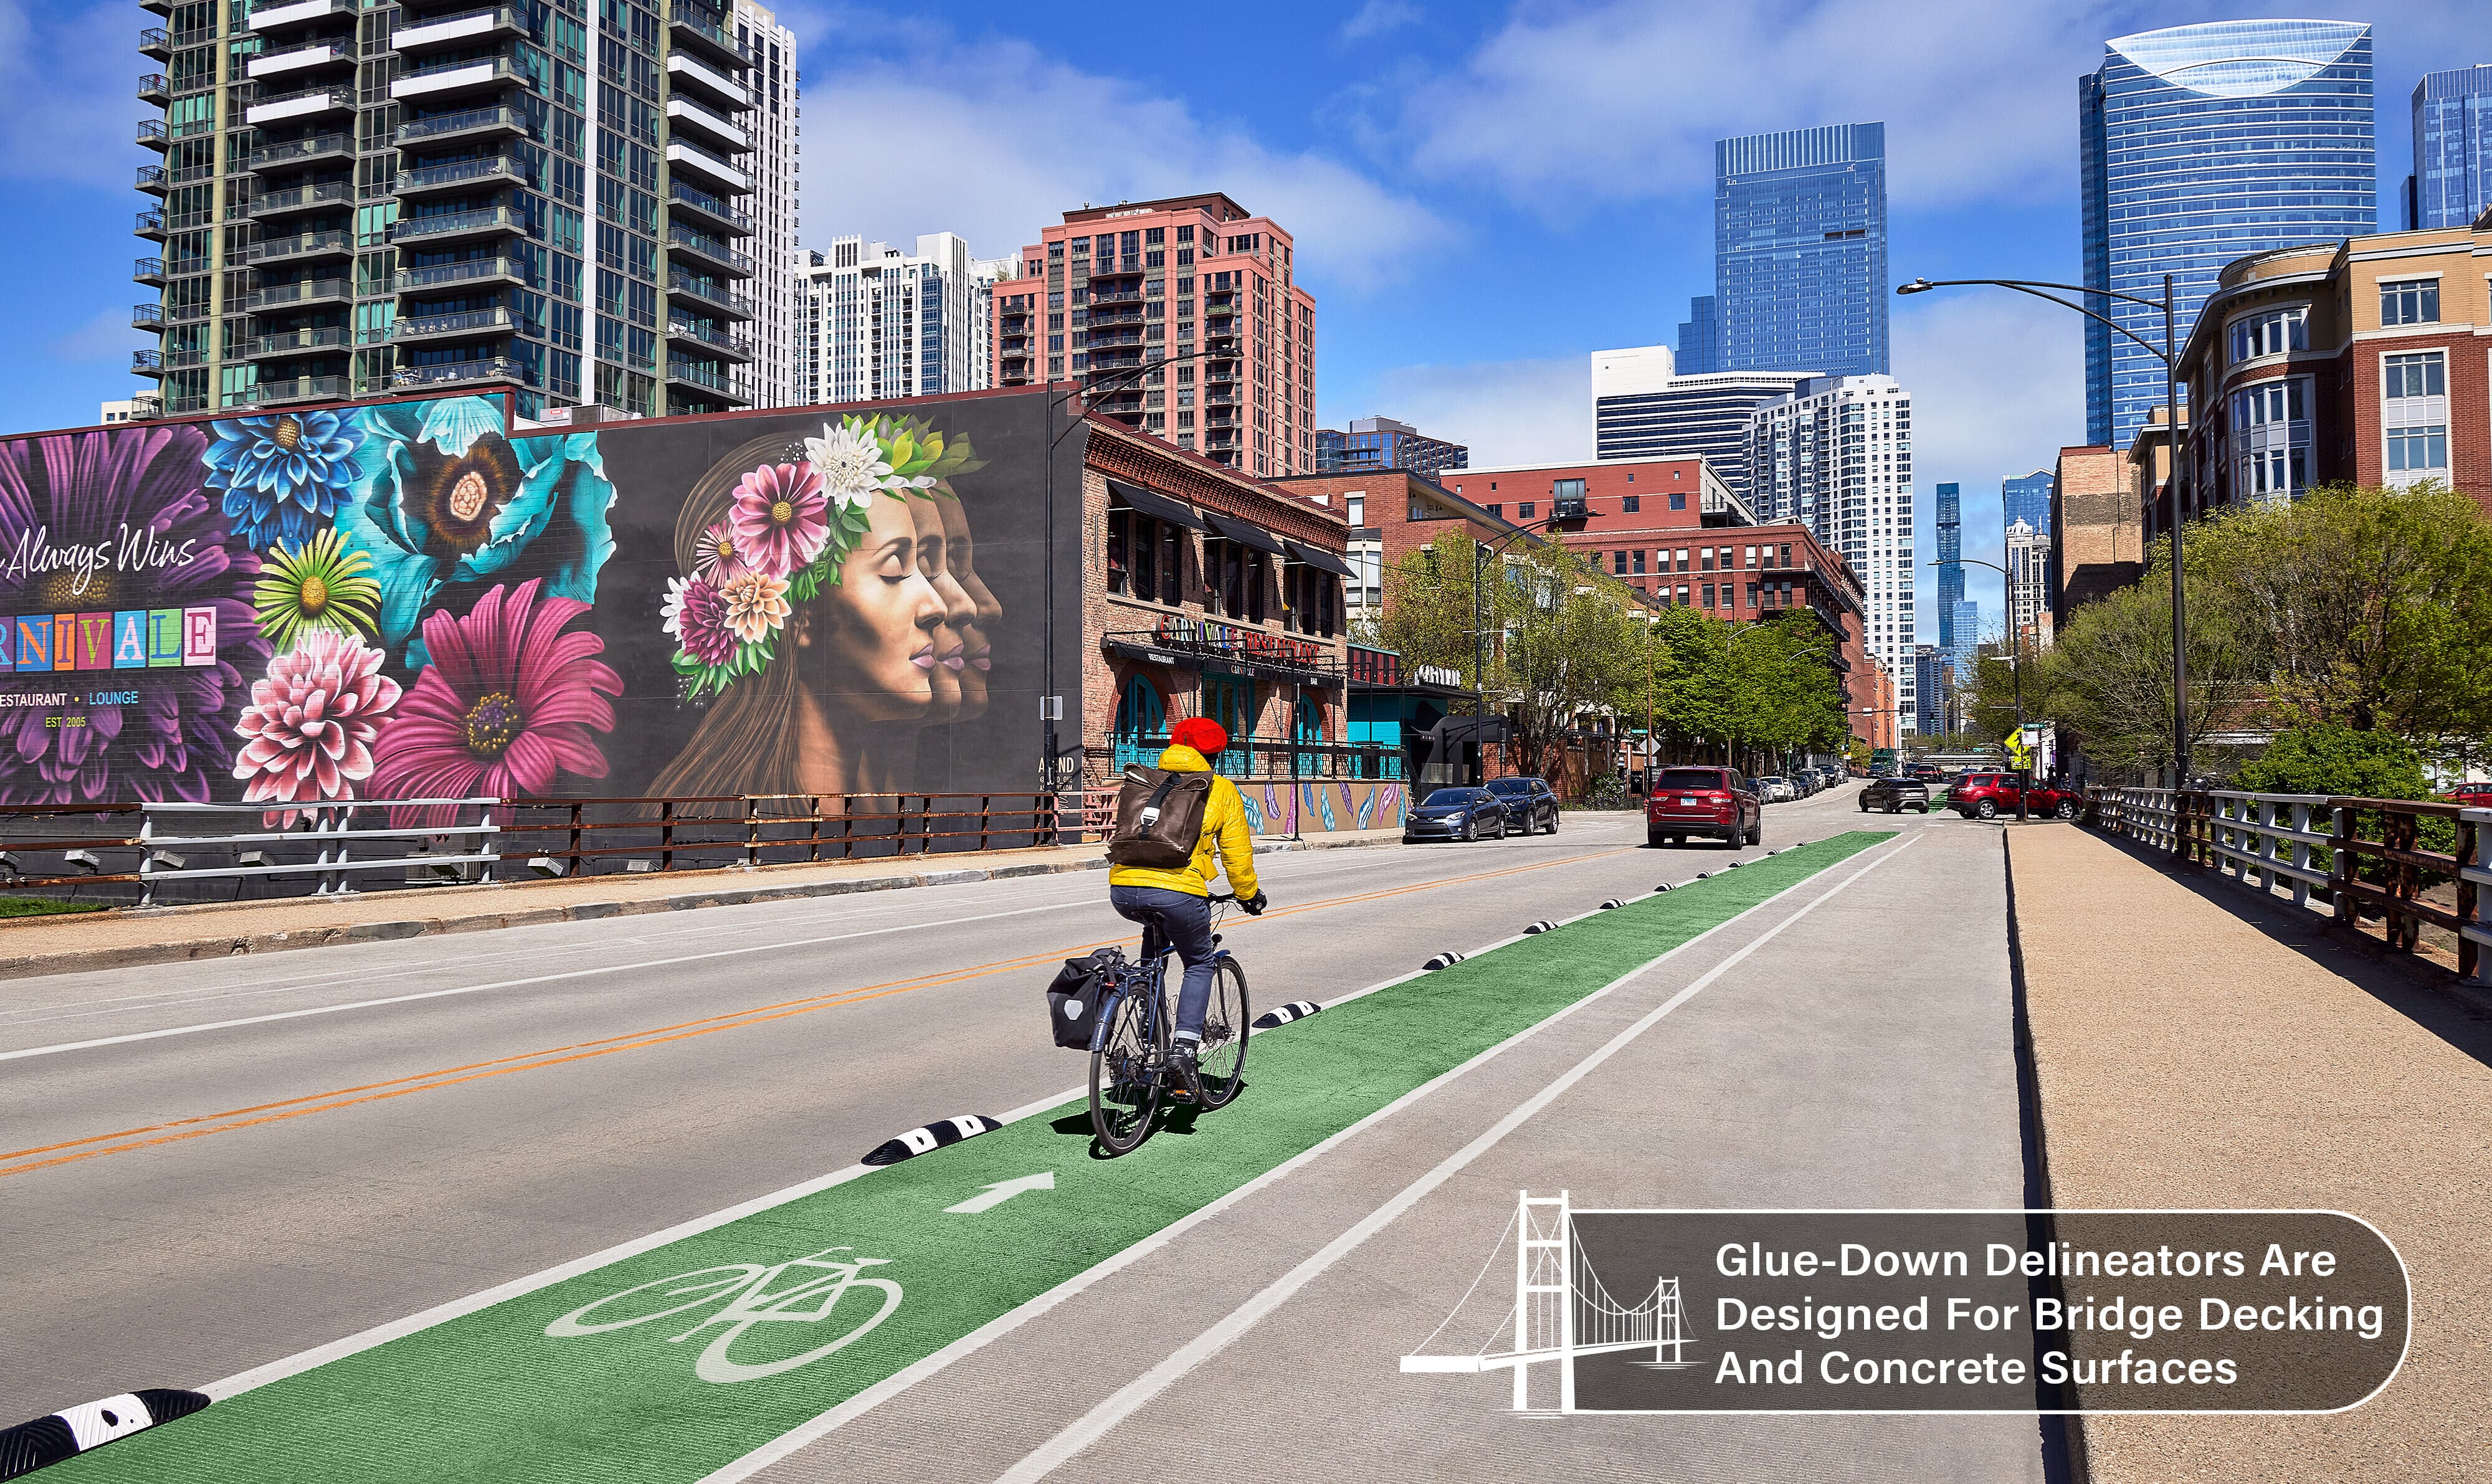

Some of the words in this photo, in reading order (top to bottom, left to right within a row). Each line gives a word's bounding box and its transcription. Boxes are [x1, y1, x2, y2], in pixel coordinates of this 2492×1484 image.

[6, 523, 112, 595] Always
[118, 523, 196, 571] Wins
[1245, 631, 1320, 665] RESTAURANT
[1148, 653, 1174, 665] RESTAURANT
[89, 691, 138, 705] LOUNGE
[66, 716, 86, 728] 2005
